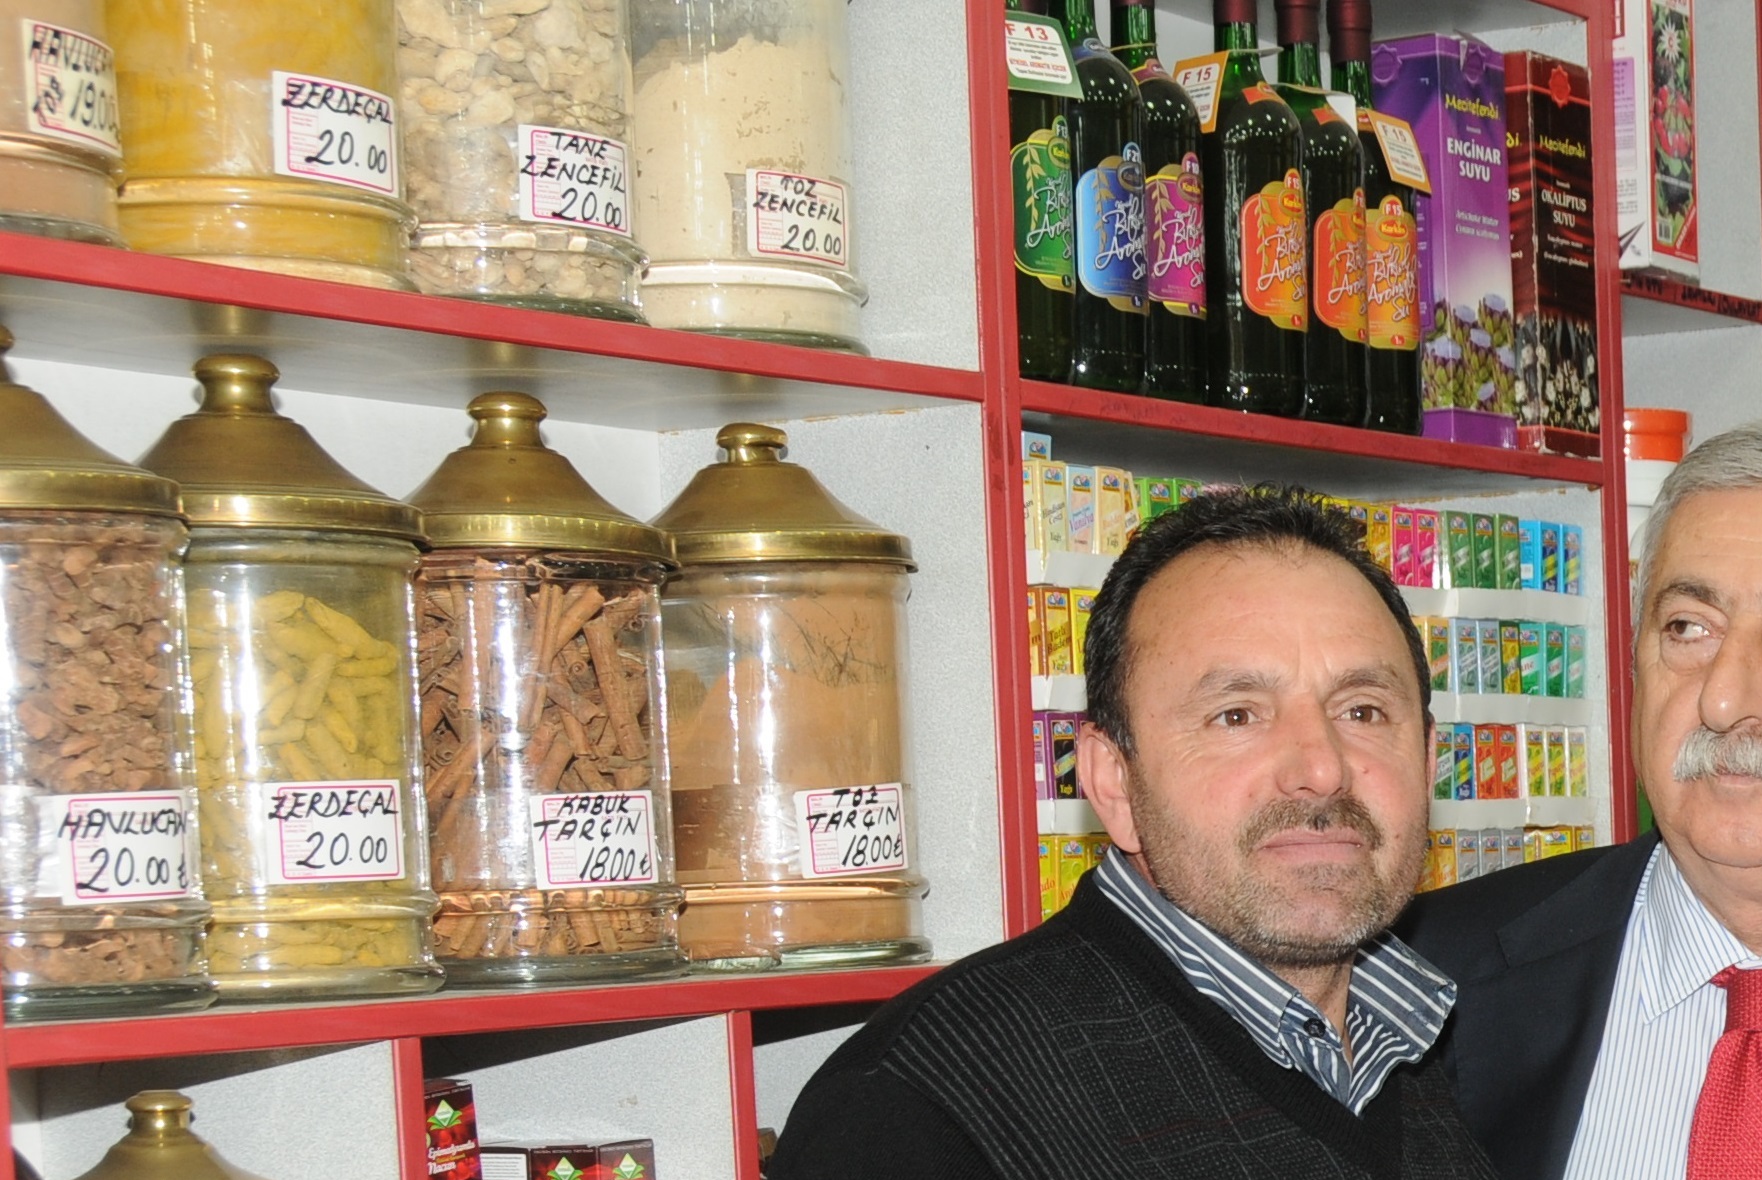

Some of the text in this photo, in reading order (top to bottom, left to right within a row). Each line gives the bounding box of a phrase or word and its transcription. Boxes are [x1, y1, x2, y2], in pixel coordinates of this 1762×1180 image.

[550, 131, 610, 160] TANE
[1446, 137, 1502, 166] ENGİNAR
[1459, 160, 1491, 183] SUYU
[780, 174, 817, 198] TOZ
[1552, 210, 1577, 229] SUYU
[558, 793, 631, 817] KABUK
[533, 811, 641, 842] TARÇIN
[805, 805, 901, 834] TARÇIN
